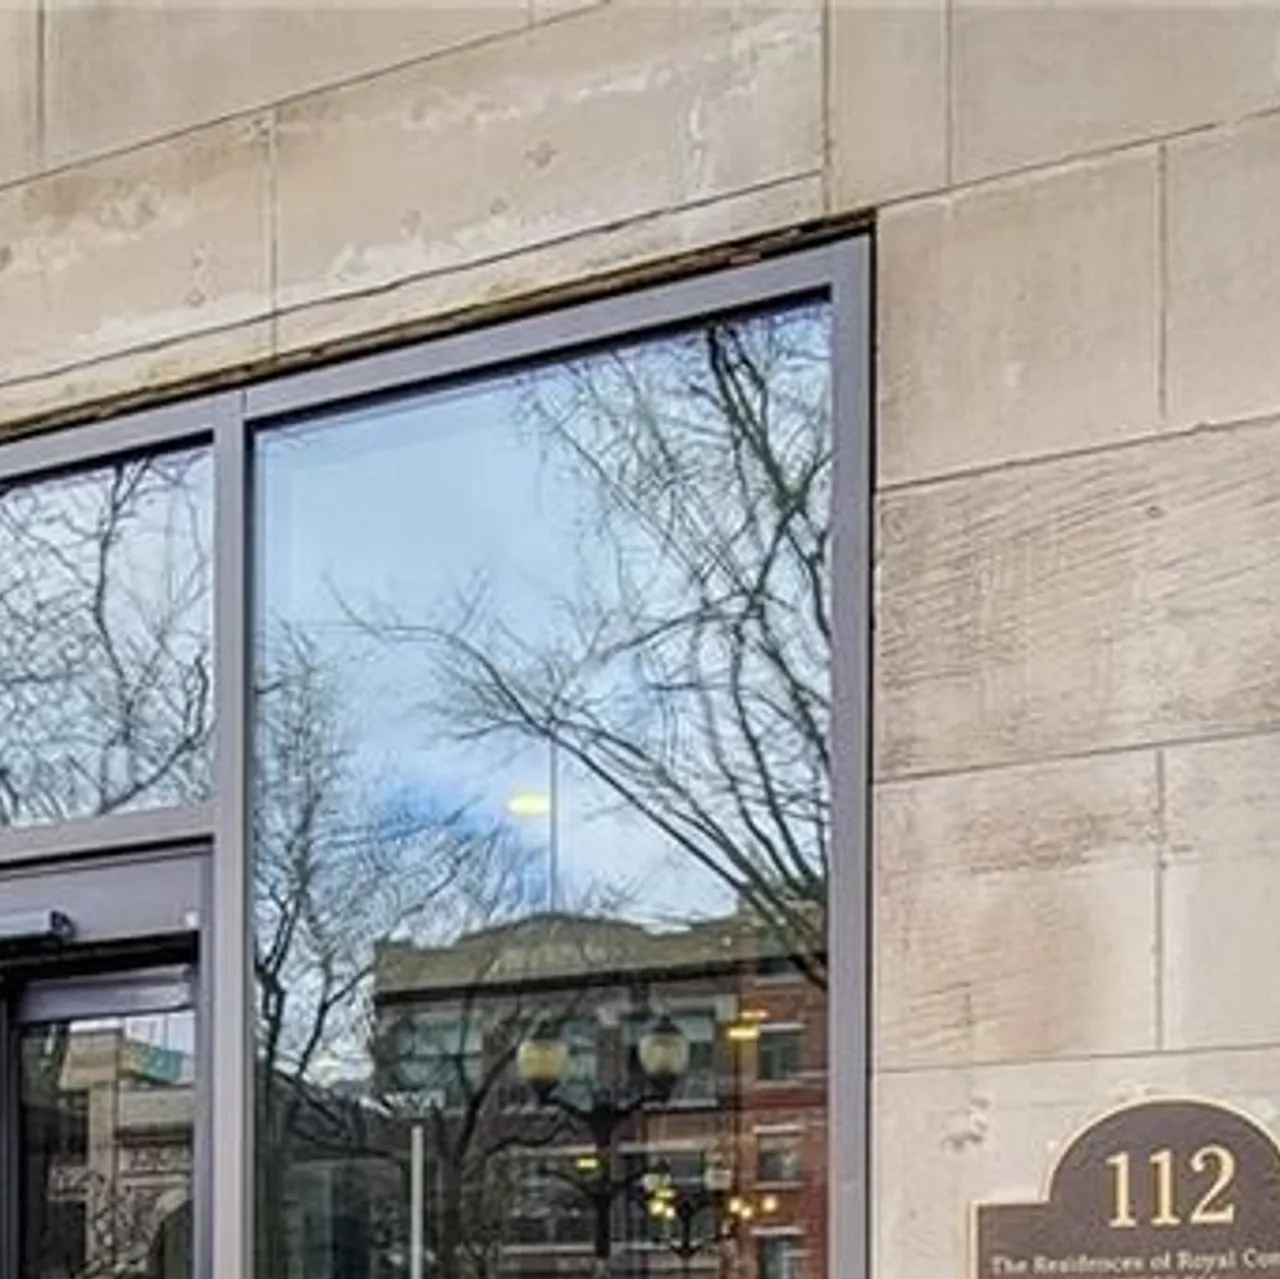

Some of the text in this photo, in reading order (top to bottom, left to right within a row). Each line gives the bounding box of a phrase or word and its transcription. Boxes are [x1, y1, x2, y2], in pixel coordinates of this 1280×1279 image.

[1104, 1142, 1237, 1229] 112
[992, 1254, 1028, 1276] The
[1032, 1252, 1146, 1275] Residences
[1150, 1249, 1171, 1270] of
[1176, 1248, 1237, 1274] Royal
